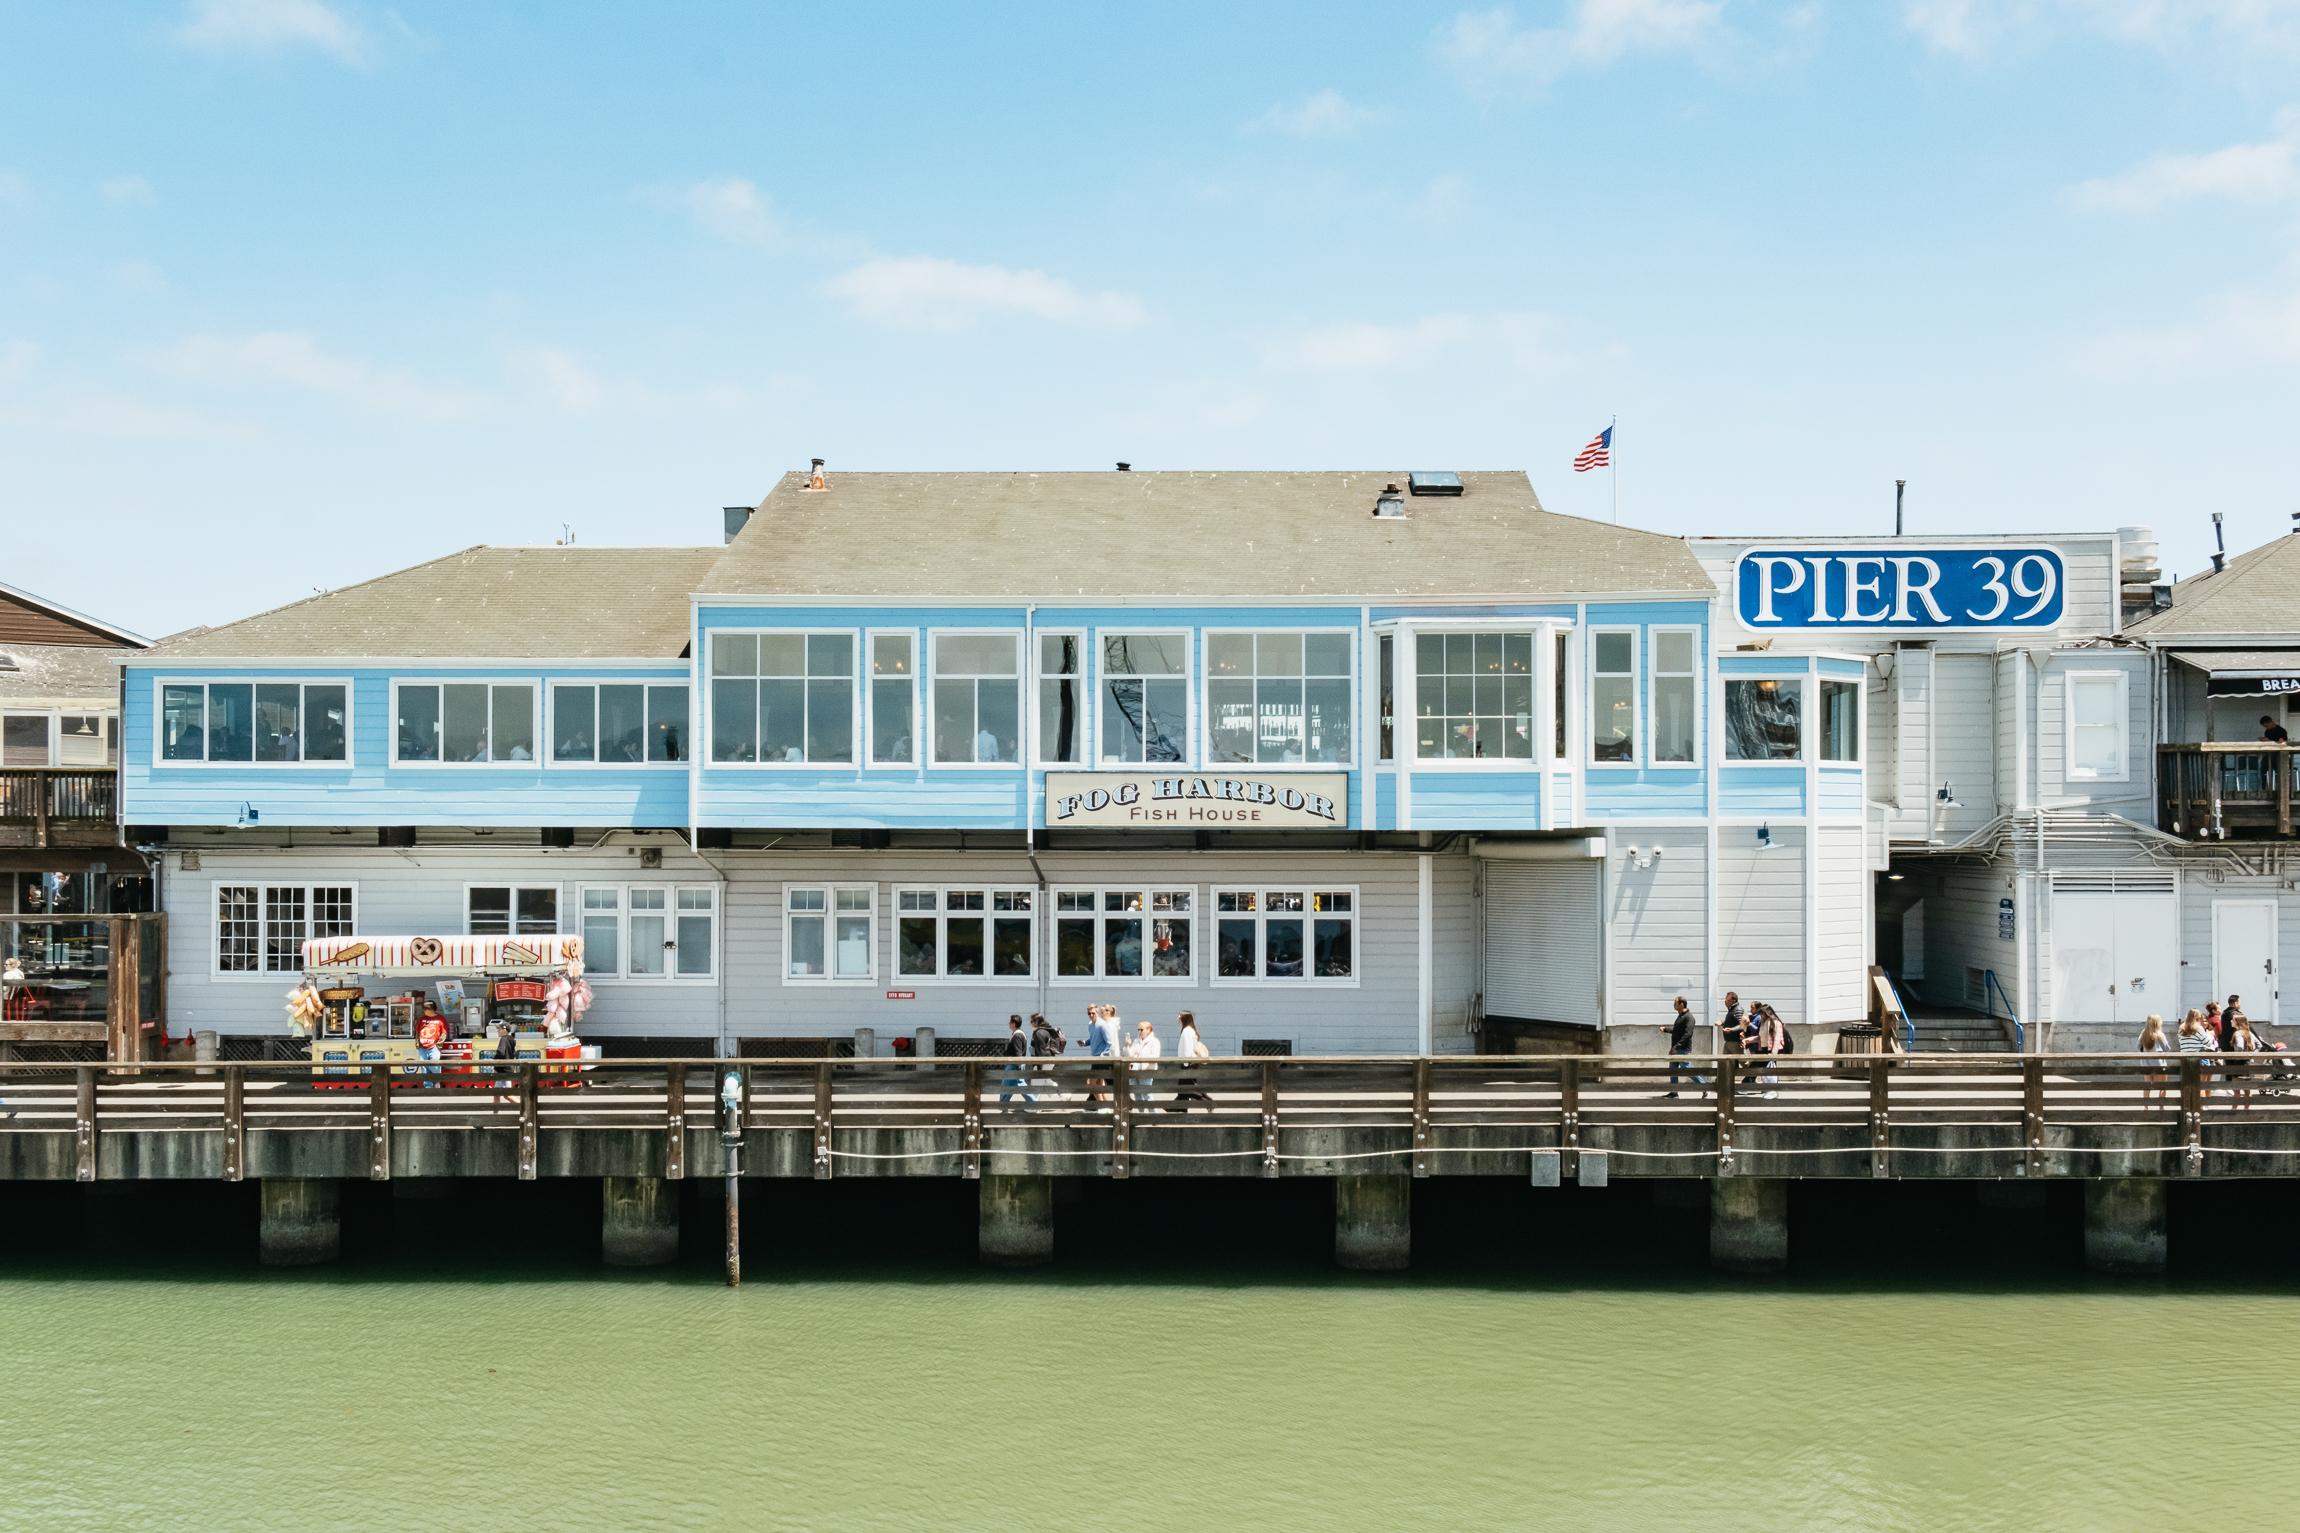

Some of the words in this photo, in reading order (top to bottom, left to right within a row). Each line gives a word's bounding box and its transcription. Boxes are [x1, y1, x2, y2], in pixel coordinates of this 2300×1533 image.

[1749, 557, 1951, 622] PIER
[1966, 555, 2057, 621] 39
[2262, 679, 2300, 691] BREA
[1057, 783, 1140, 819] FOG
[1152, 778, 1335, 820] HARBOR
[1130, 807, 1176, 821] FISH
[1189, 807, 1261, 821] HOUSE
